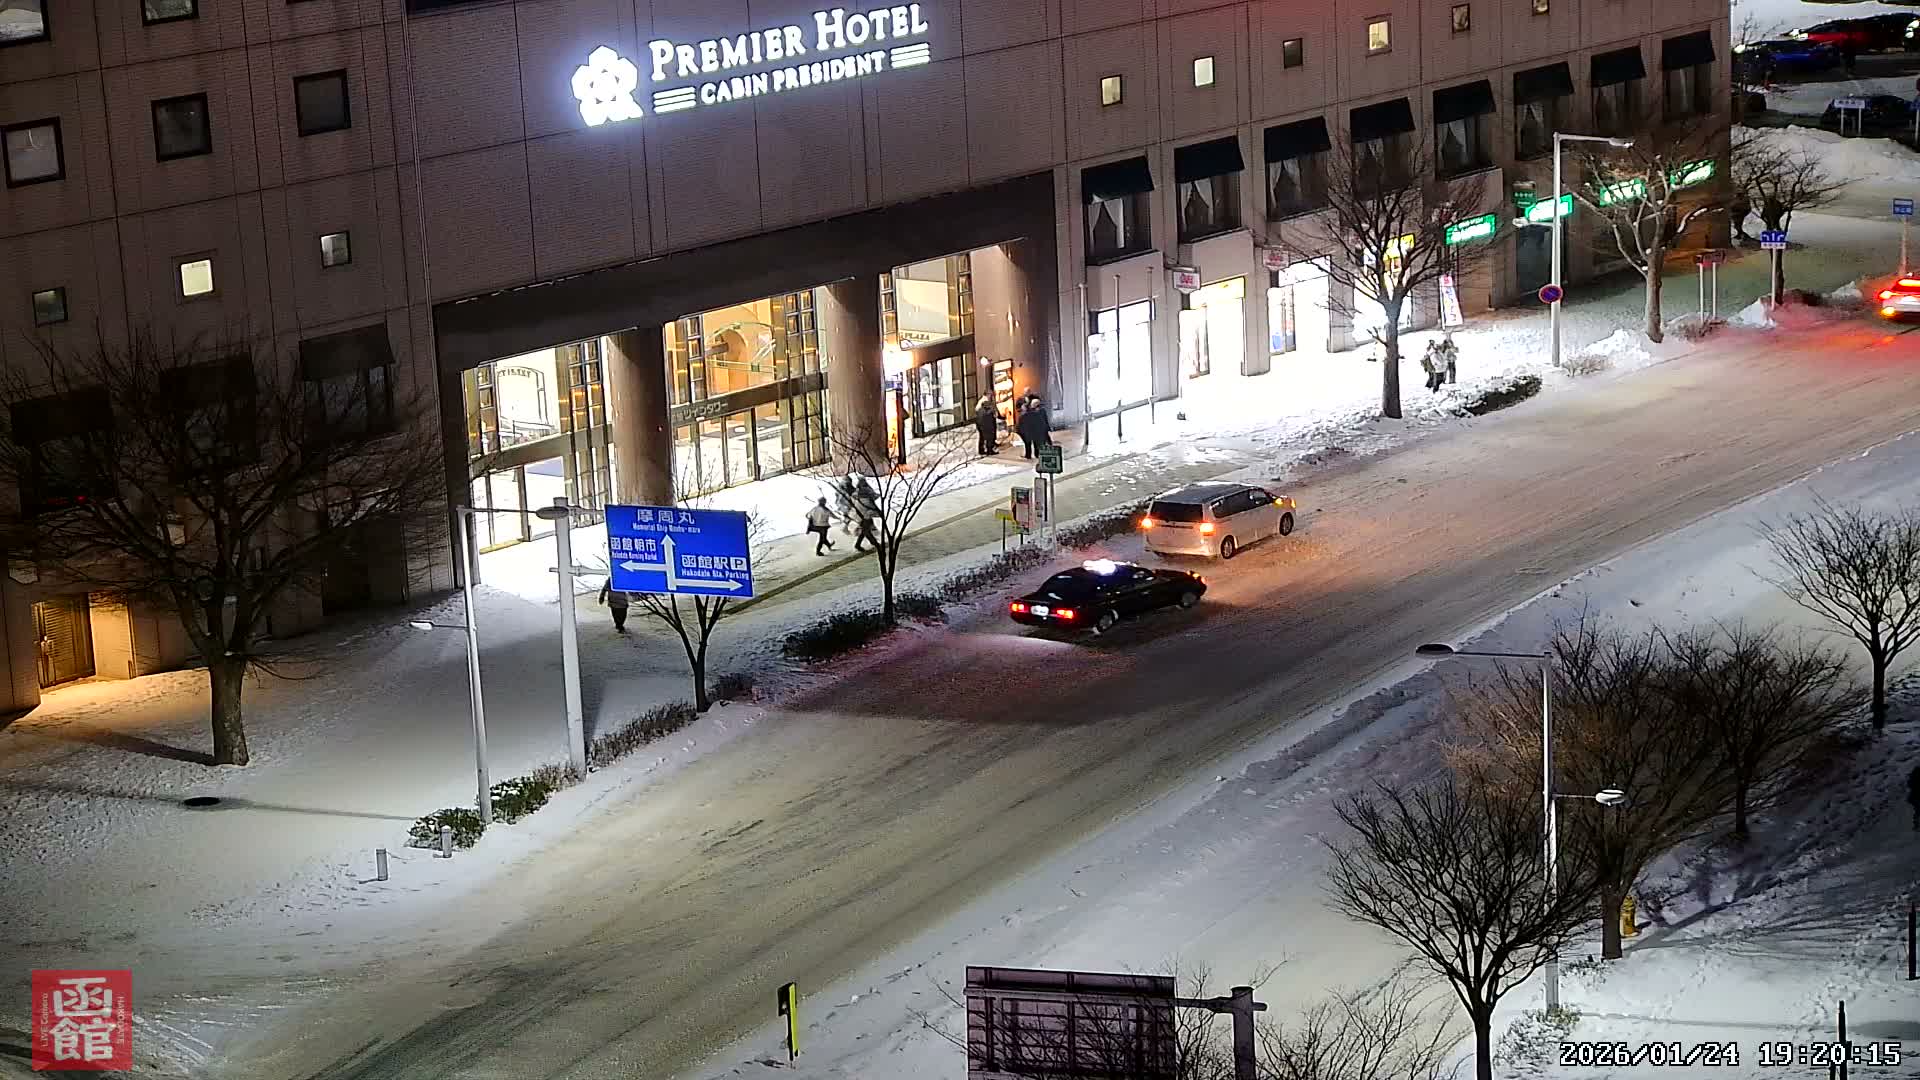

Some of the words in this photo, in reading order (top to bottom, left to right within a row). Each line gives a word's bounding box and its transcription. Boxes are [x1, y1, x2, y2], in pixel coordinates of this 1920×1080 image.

[649, 25, 806, 81] PREMIER
[813, 3, 929, 50] HOTEL
[699, 72, 769, 105] CABIN
[772, 51, 887, 92] PRESIDENT
[637, 508, 696, 525] 摩周丸
[610, 537, 657, 552] 函館朝市
[681, 568, 711, 577] Hakodate
